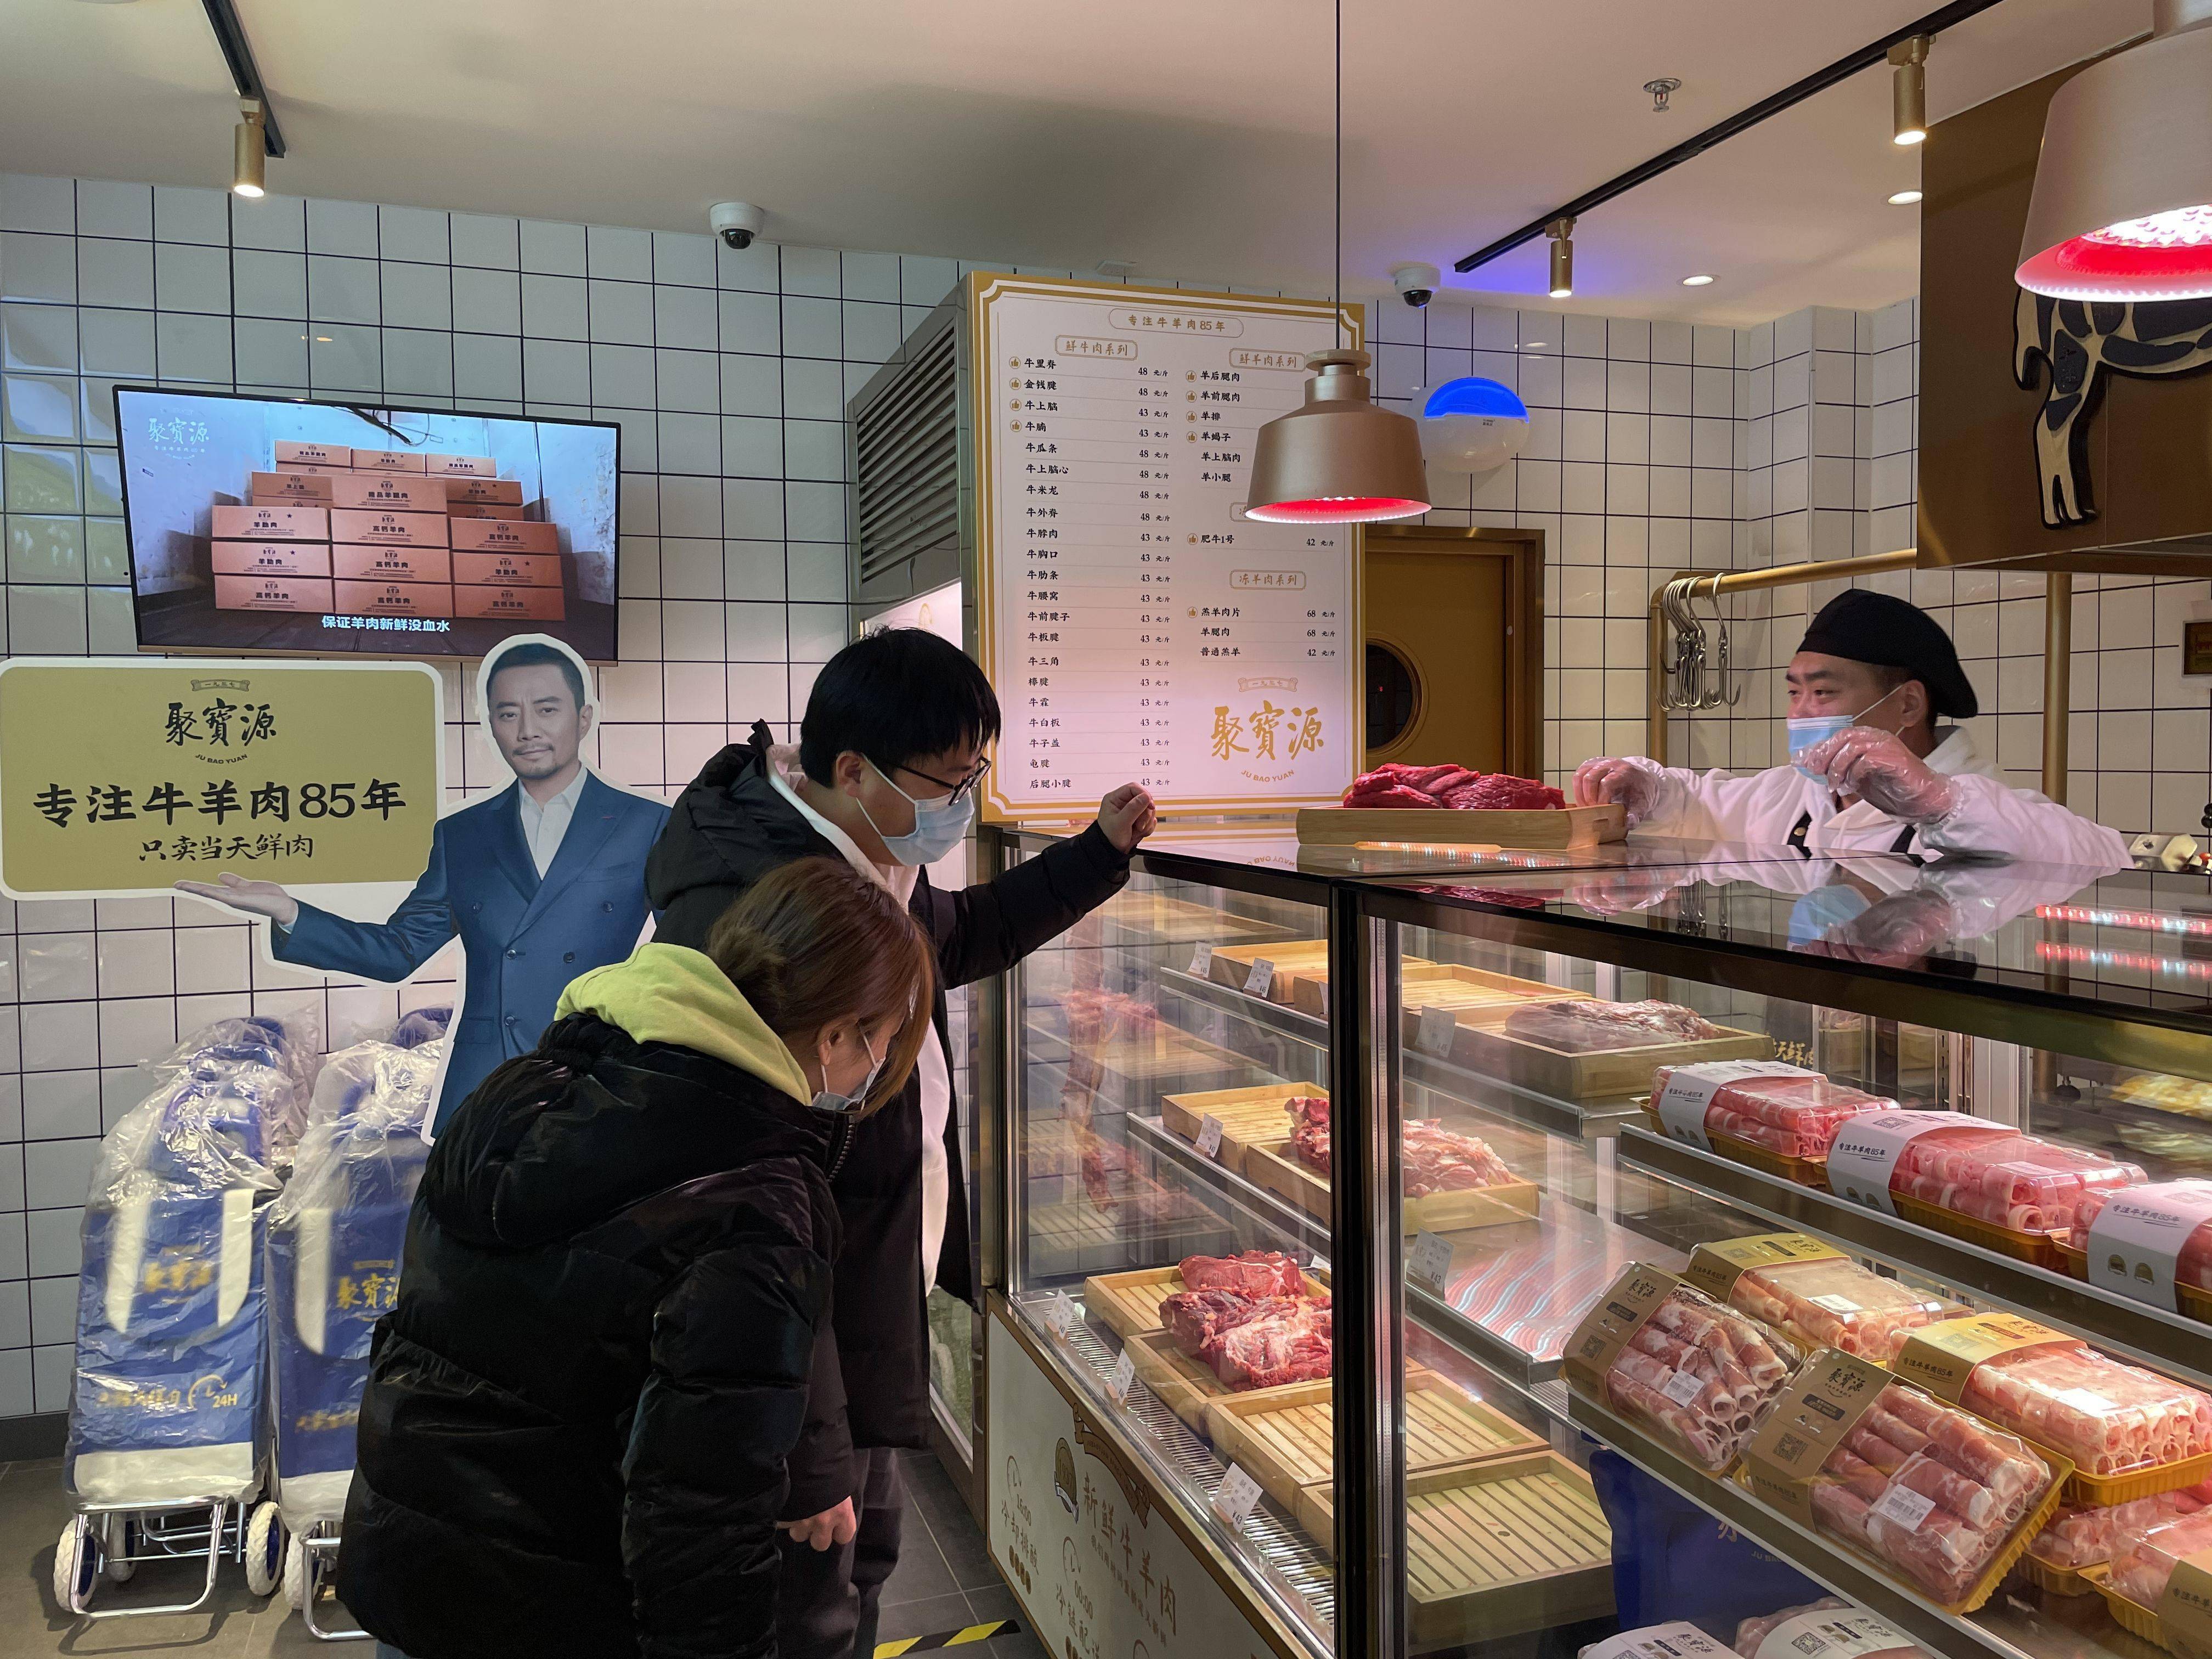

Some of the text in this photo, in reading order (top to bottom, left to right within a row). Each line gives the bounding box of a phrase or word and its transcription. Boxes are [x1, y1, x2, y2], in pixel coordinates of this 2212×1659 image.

[1128, 314, 1226, 332] 专注牛羊肉85年
[1065, 340, 1127, 356] 鲜牛肉系列
[1024, 358, 1057, 370] 牛里脊
[1138, 367, 1148, 376] 48
[1239, 353, 1297, 368] 鲜羊肉系列
[1200, 370, 1240, 382] 羊后腿肉
[1024, 379, 1057, 391] 金钱腱
[1138, 387, 1148, 396] 48
[1200, 390, 1240, 403] 羊前腿肉
[1024, 400, 1058, 411] 牛上脑
[1138, 408, 1148, 417] 43
[1200, 411, 1221, 421] 羊排
[1025, 421, 1046, 432] 牛腩
[1138, 428, 1149, 437] 43
[1200, 431, 1231, 442] 羊蝎子
[1025, 442, 1058, 454] 牛瓜条
[1139, 449, 1149, 458] 48
[1200, 451, 1240, 463] 羊上脑肉
[1025, 463, 1069, 475] 牛上脑心
[1139, 470, 1149, 478] 48
[1201, 471, 1232, 483] 羊小腿
[1026, 484, 1059, 495] 牛米龙
[1139, 490, 1149, 499] 48
[1025, 507, 1058, 518] 牛外脊
[1140, 513, 1150, 521] 48
[1026, 528, 1058, 539] 牛脖肉
[1140, 533, 1150, 541] 43
[1200, 534, 1235, 544] 肥牛1号
[1306, 538, 1316, 546] 42
[1026, 549, 1058, 560] 牛胸口
[1140, 554, 1150, 562] 43
[1026, 569, 1059, 580] 牛肋条
[1141, 574, 1150, 582] 43
[1239, 574, 1297, 586] 冻羊肉系列
[1026, 590, 1059, 601] 牛腰窝
[1140, 594, 1150, 602] 43
[1027, 611, 1070, 622] 牛前腱子
[1140, 614, 1150, 623] 43
[1307, 610, 1316, 618] 68
[321, 615, 450, 633] 保证羊肉新鲜没血水
[1027, 632, 1060, 642] 牛板腱
[1140, 635, 1150, 643] 43
[1200, 627, 1230, 637] 羊腿肉
[1307, 648, 1317, 657] 42
[1027, 656, 1059, 667] 牛三角
[1140, 658, 1149, 667] 43
[1028, 676, 1049, 687] 棒腱
[1140, 679, 1149, 687] 43
[1140, 698, 1149, 707] 43
[165, 697, 276, 746] 聚寶源
[1028, 718, 1061, 728] 牛白板
[1140, 718, 1150, 726] 43
[1211, 700, 1324, 760] 聚寶源
[1029, 737, 1060, 748] 牛子盖
[1140, 738, 1150, 747] 43
[225, 754, 248, 764] YUAN
[1140, 758, 1150, 766] 43
[1141, 778, 1150, 786] 43
[1241, 769, 1294, 782] JU BAO YUAN
[33, 778, 407, 828] 专注牛羊肉85年
[139, 833, 314, 861] 只卖当天鲜肉
[212, 1393, 238, 1408] 24H
[1017, 1494, 1031, 1526] 16:00
[1232, 1510, 1243, 1525] ¥43
[1084, 1471, 1176, 1636] 新鲜牛羊肉
[1074, 1580, 1093, 1620] 00:00
